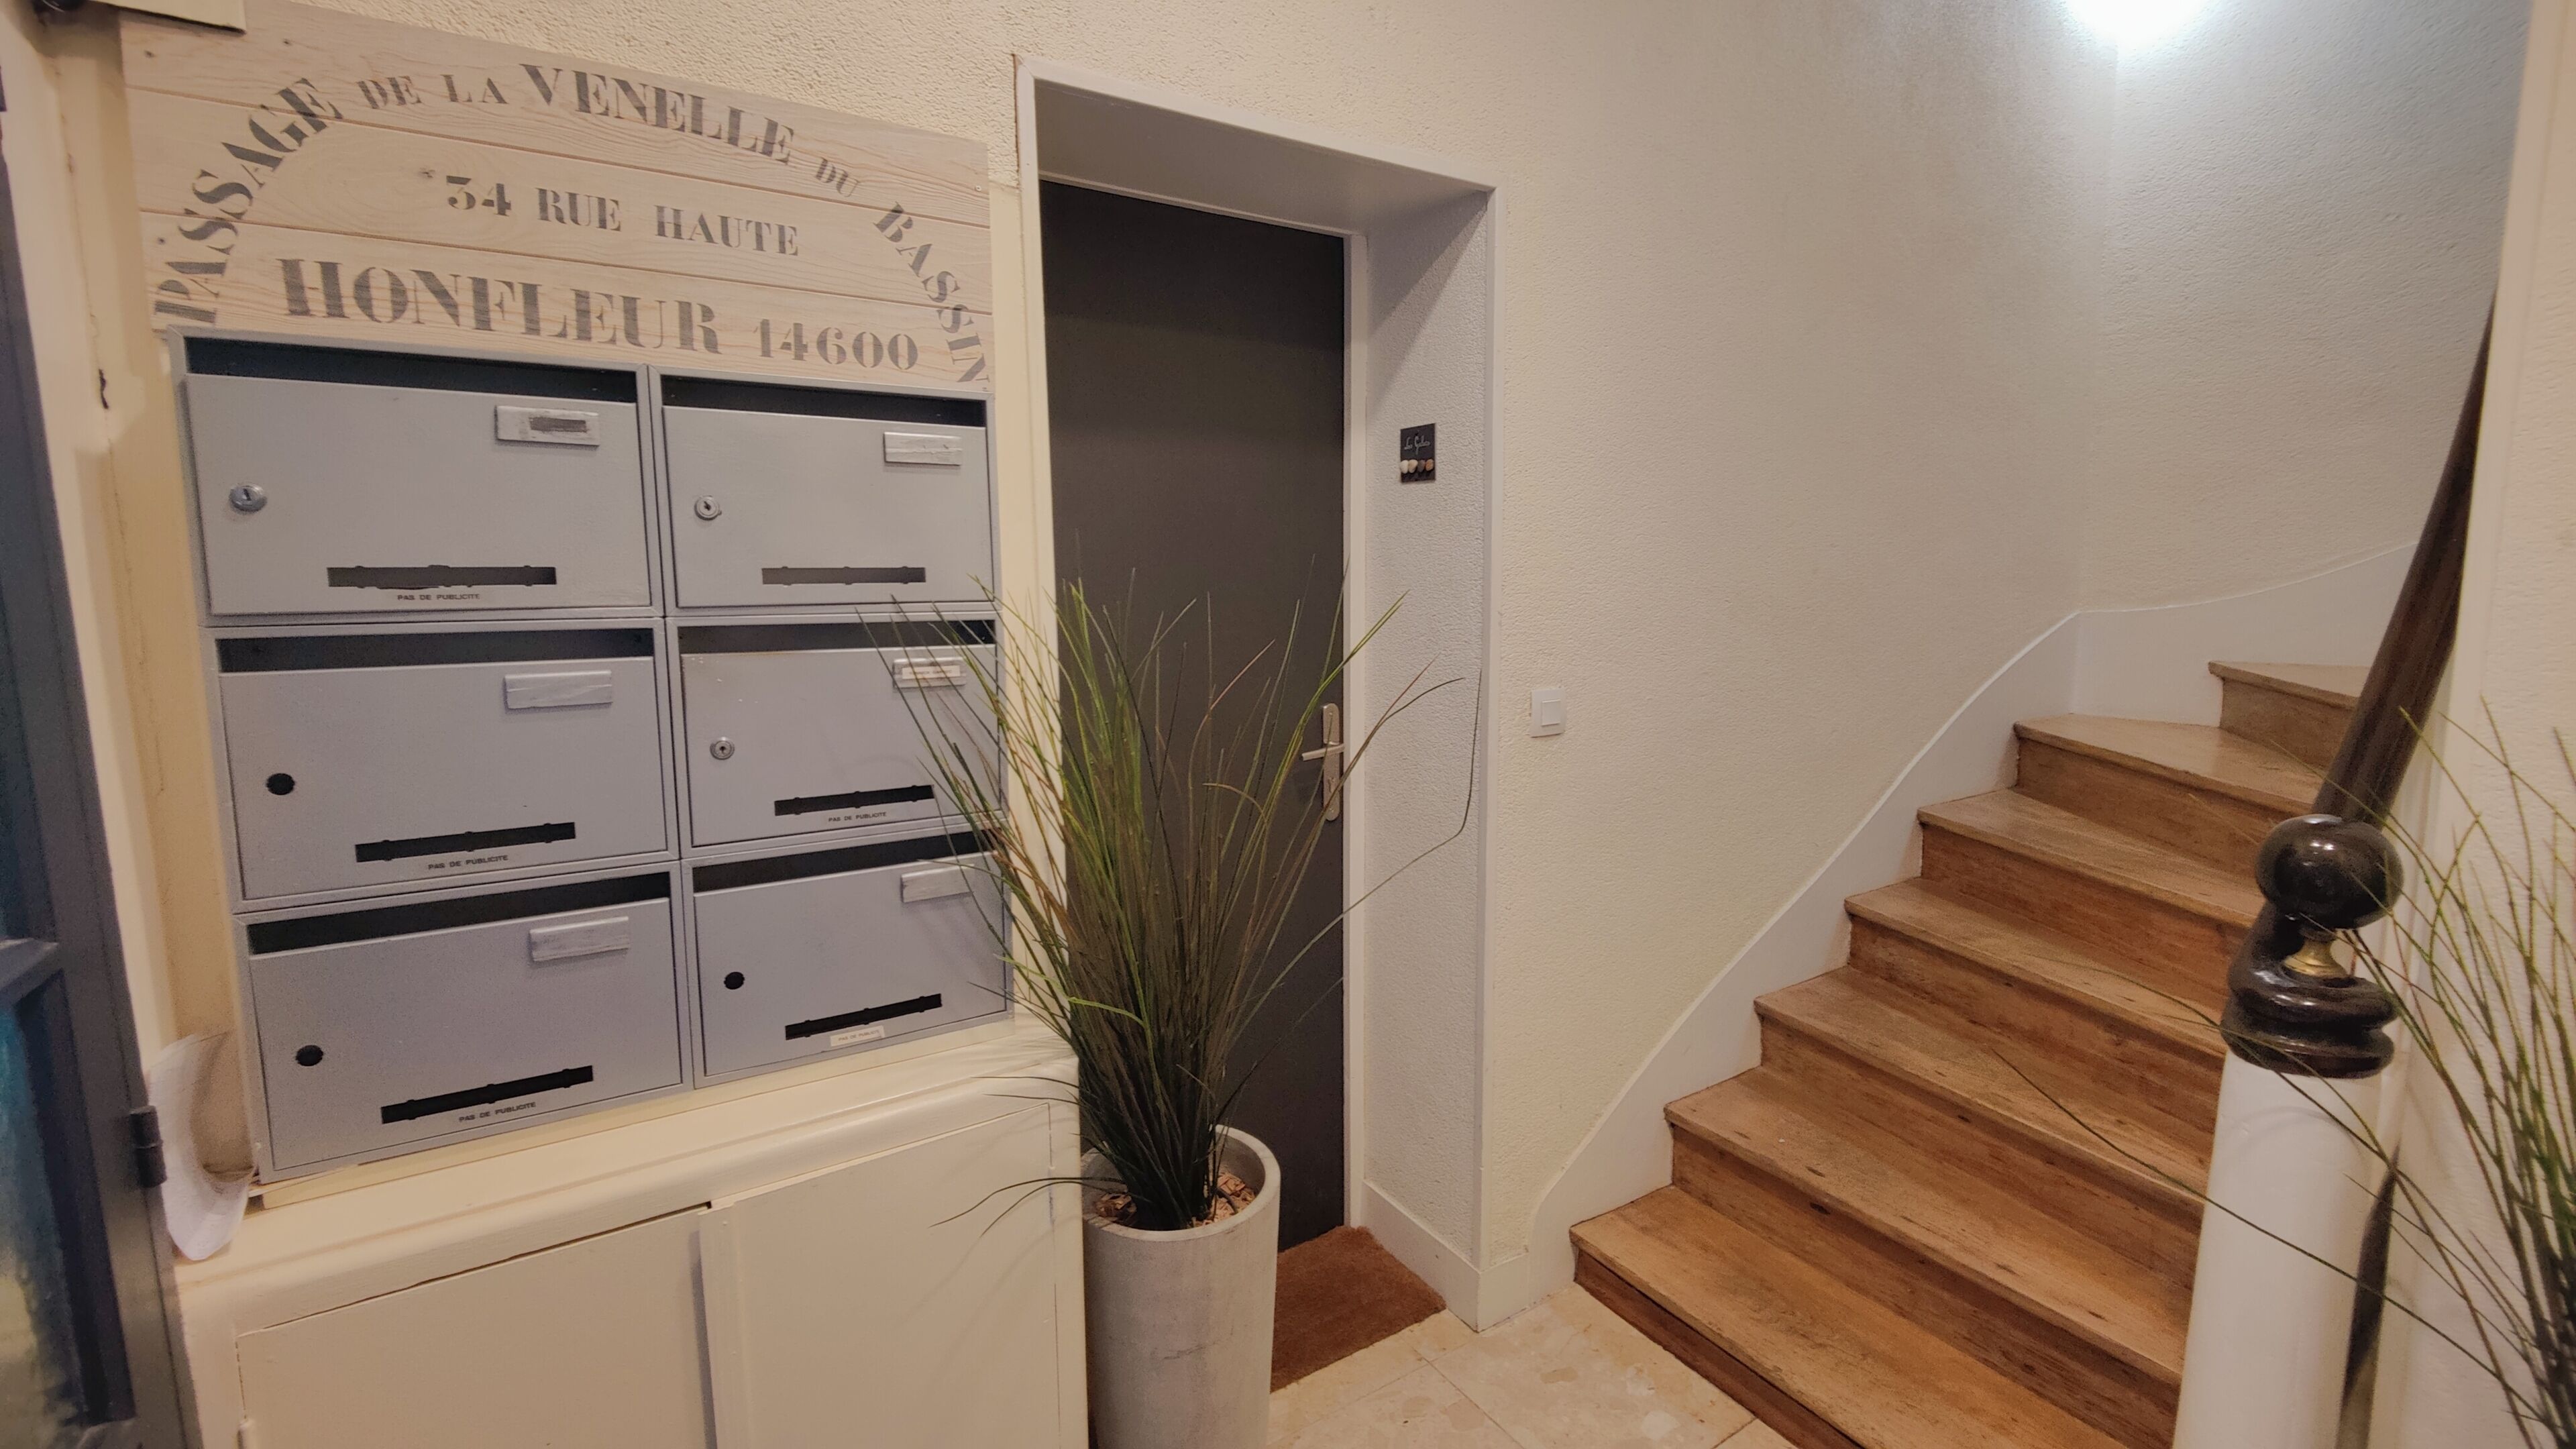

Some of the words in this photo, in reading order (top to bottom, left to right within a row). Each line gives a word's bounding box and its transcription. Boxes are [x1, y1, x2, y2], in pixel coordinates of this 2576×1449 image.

[154, 77, 343, 325] PASSAGE
[356, 75, 423, 110] DE
[440, 73, 509, 105] LA
[519, 63, 795, 165] VENELLE
[813, 157, 863, 198] DU
[873, 201, 991, 383] BASSIN
[445, 175, 512, 217] 34
[535, 186, 621, 232] RUE
[653, 205, 799, 256] HAUTE
[276, 258, 723, 356] HONFLEUR
[752, 318, 918, 370] 14600
[466, 855, 508, 865] PUBLICITE
[458, 1114, 476, 1122] PAS
